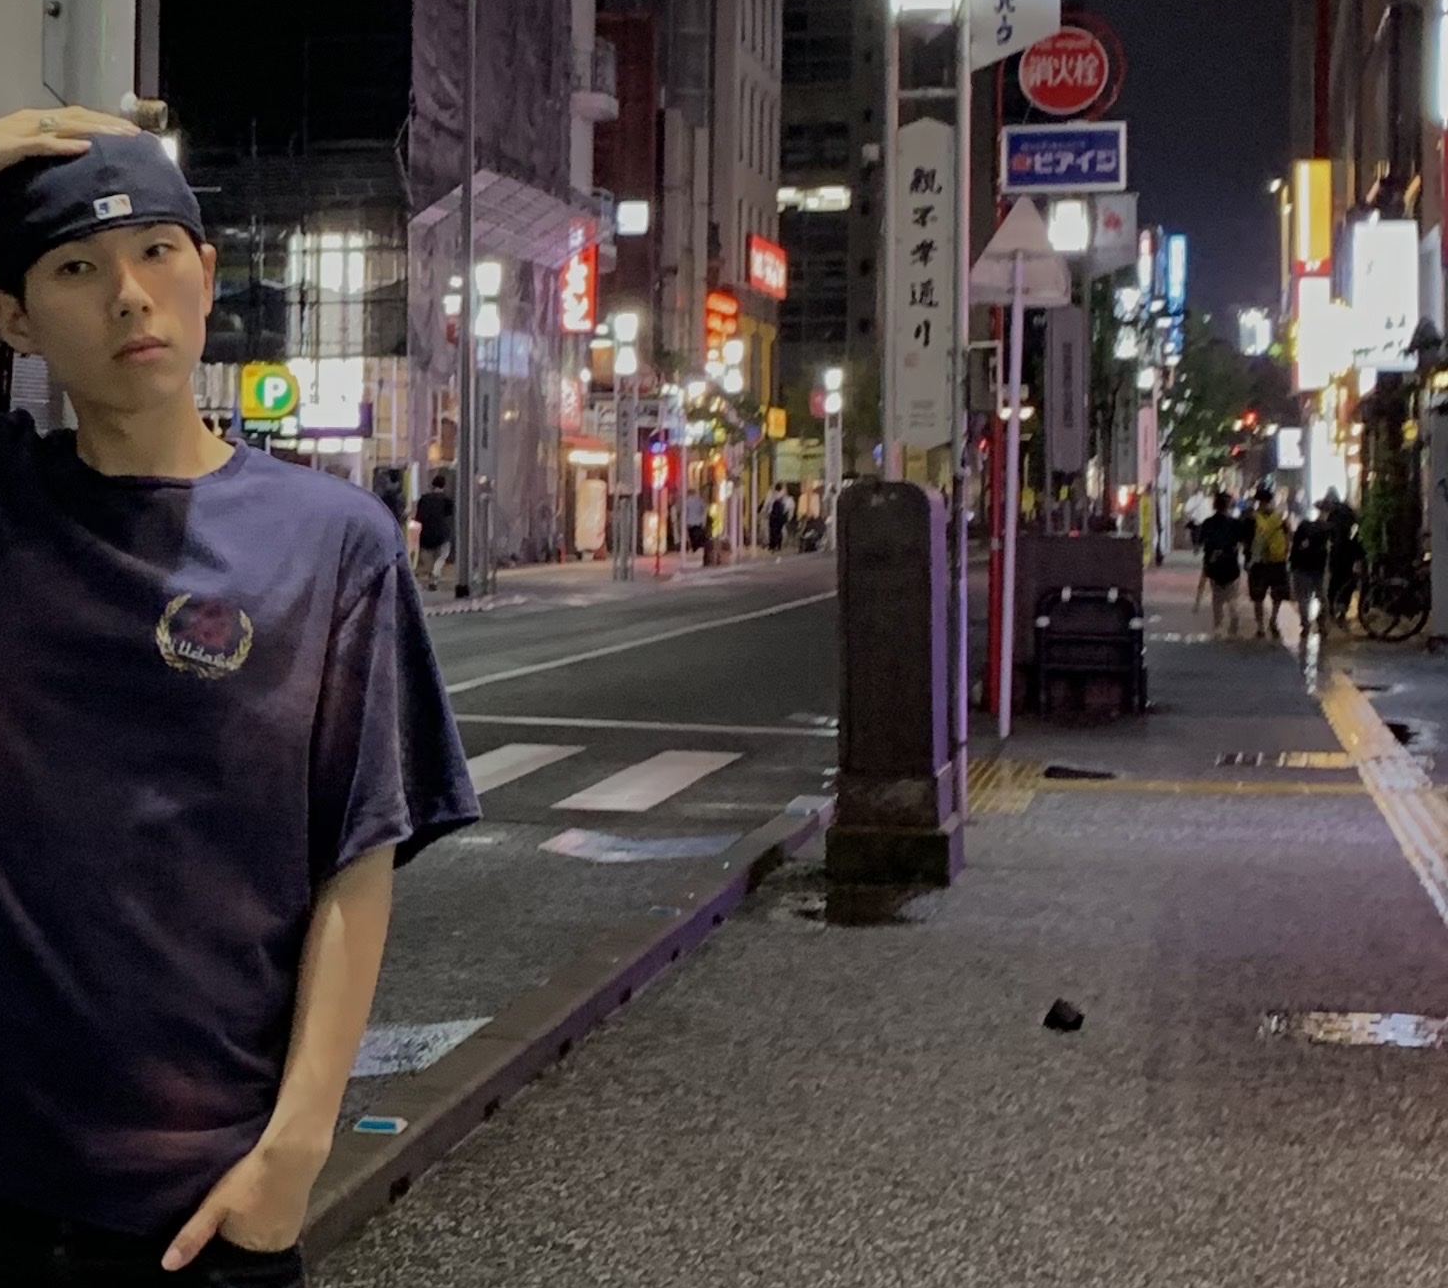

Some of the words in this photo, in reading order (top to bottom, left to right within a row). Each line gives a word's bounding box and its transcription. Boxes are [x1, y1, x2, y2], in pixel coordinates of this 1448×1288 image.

[1027, 53, 1099, 87] 消火栓
[264, 377, 287, 408] P
